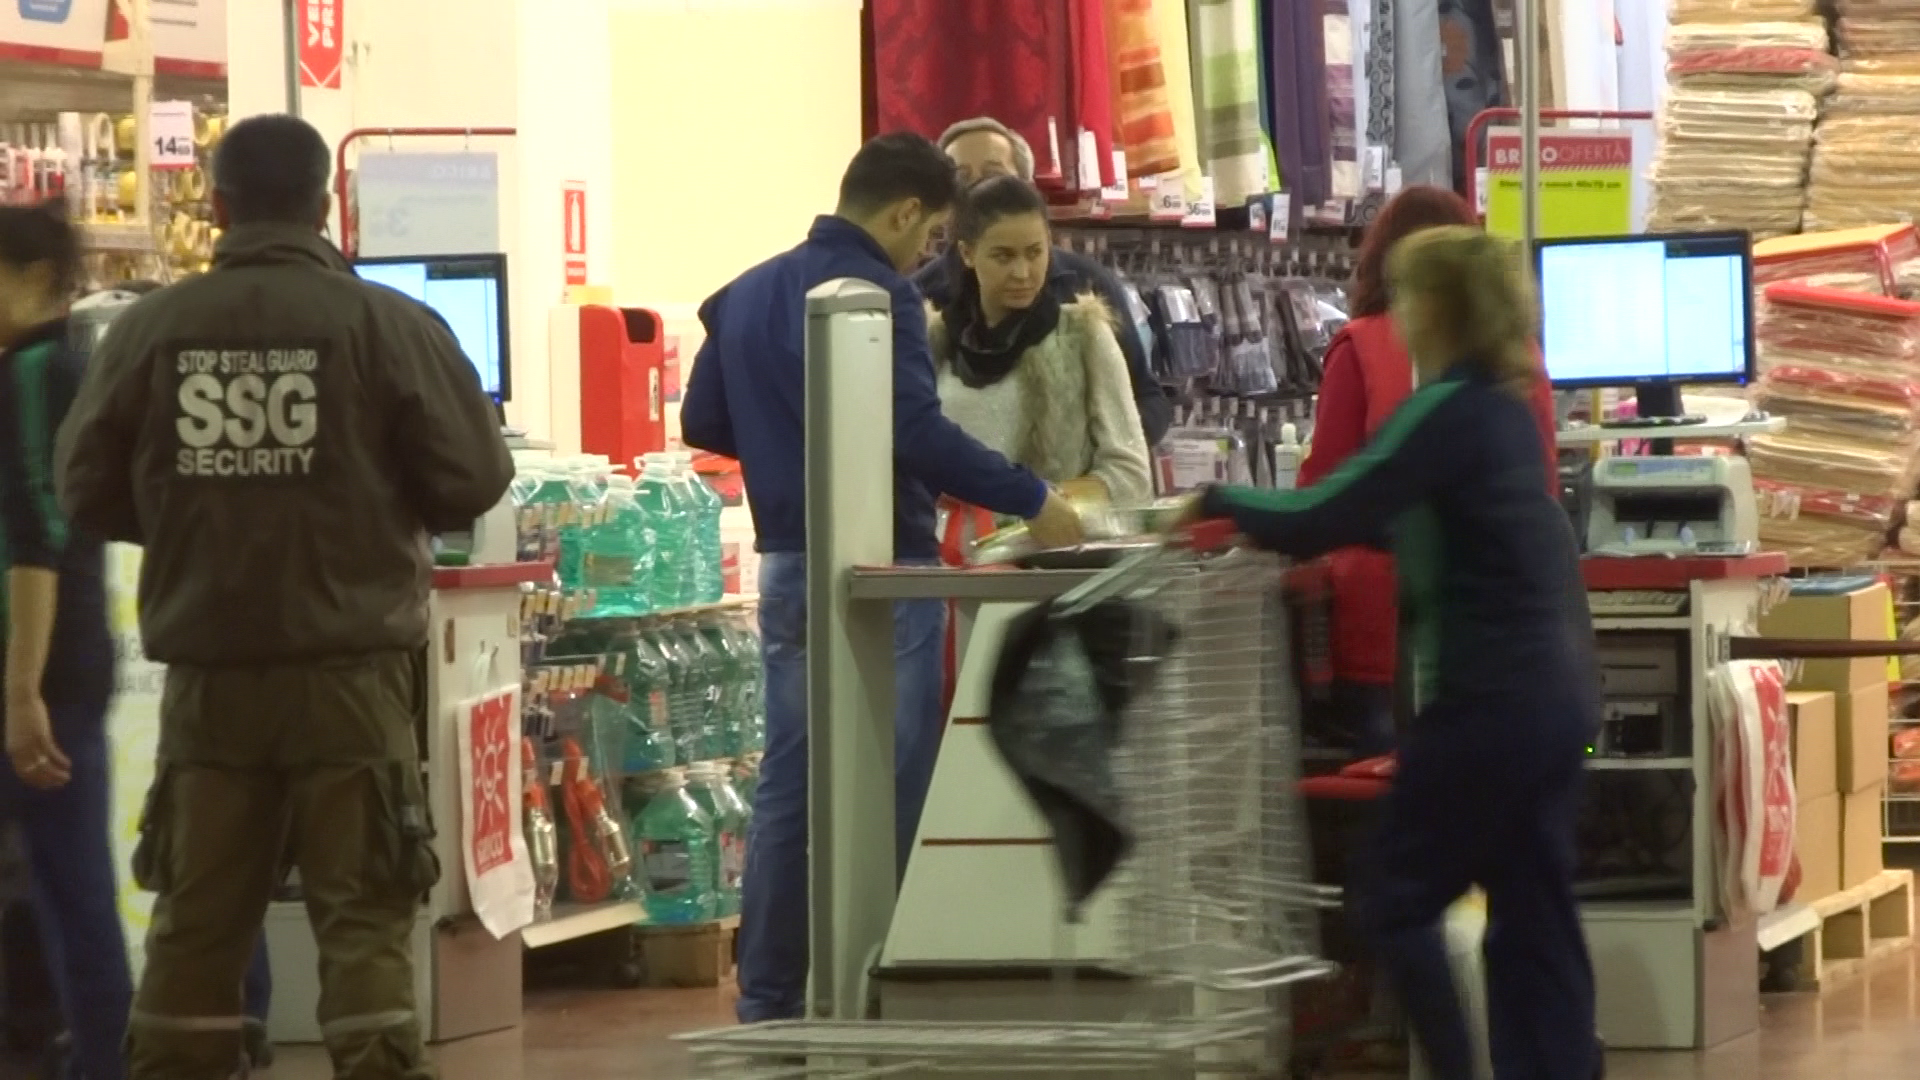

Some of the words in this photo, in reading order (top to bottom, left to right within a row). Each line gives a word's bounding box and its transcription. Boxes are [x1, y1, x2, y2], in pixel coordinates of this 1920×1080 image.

[154, 136, 177, 156] 14
[178, 350, 216, 373] STOP
[220, 349, 265, 374] STEAL
[267, 349, 317, 372] GUARD
[176, 373, 317, 447] SSG
[177, 448, 314, 475] SECURITY
